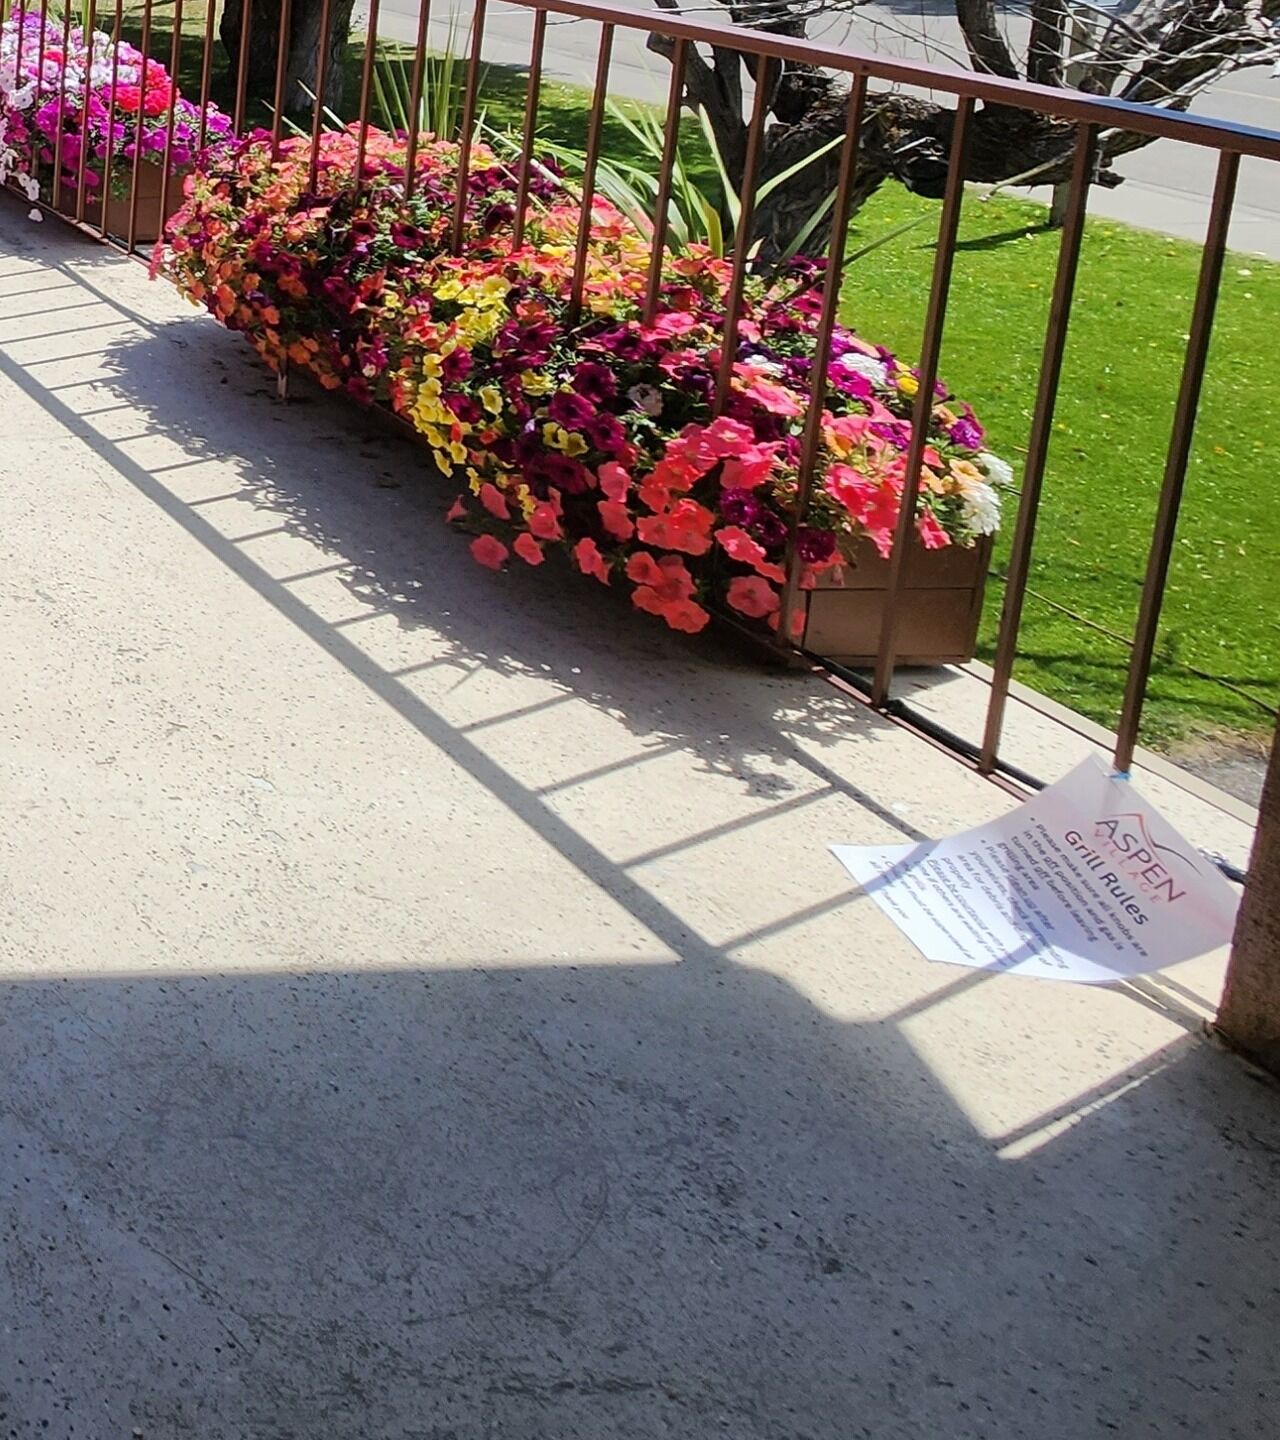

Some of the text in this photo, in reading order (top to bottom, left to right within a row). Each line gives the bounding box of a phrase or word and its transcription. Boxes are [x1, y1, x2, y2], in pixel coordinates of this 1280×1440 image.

[939, 856, 974, 890] properly
[982, 845, 1012, 873] Please
[1032, 908, 1056, 930] after
[994, 841, 1041, 889] grilling area
[1009, 836, 1100, 942] turned off before leaving
[1022, 830, 1125, 950] in the off position and gas is
[1033, 824, 1148, 957] Please make sure all knobs are
[1063, 829, 1150, 926] Grill Rules
[1094, 828, 1163, 904] VILLAGE
[1095, 821, 1186, 901] ASPEN
